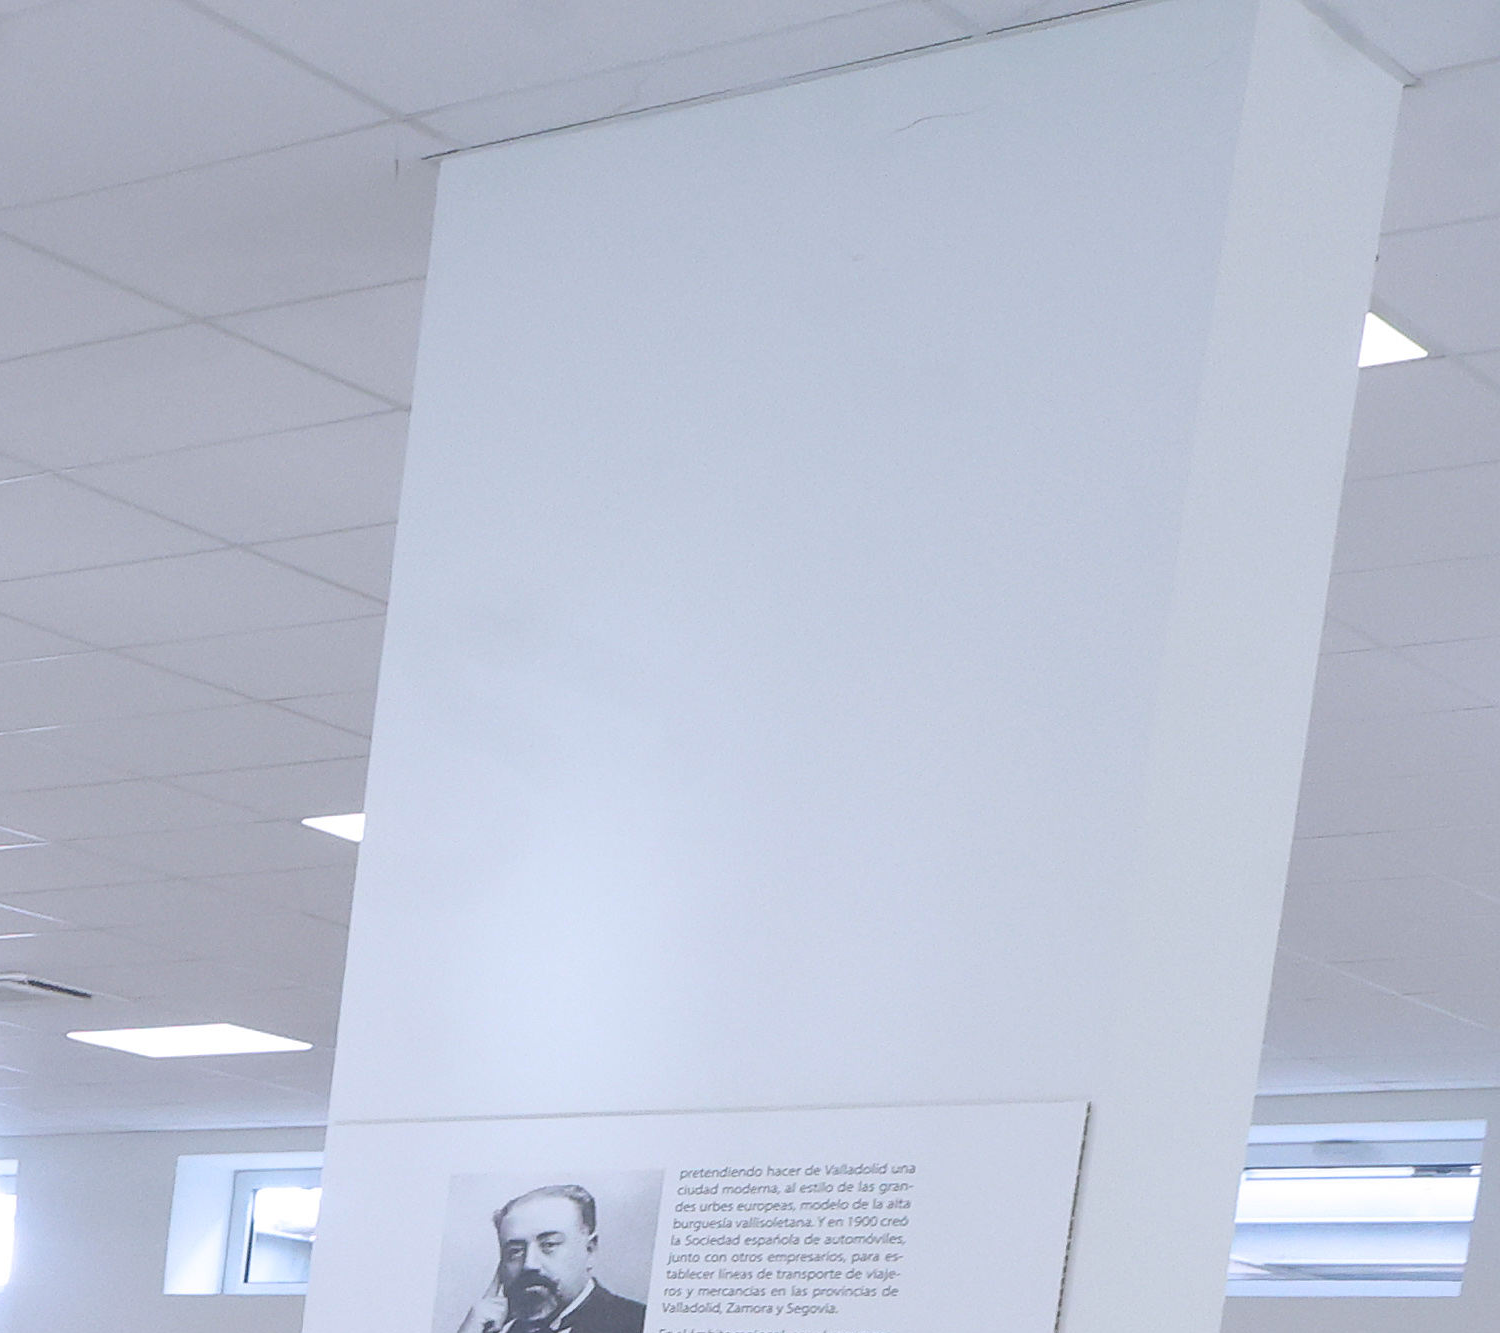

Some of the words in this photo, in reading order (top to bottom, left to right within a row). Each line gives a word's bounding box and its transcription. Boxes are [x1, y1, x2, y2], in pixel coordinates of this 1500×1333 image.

[679, 1165, 764, 1181] pretendiendo
[766, 1165, 803, 1177] hacer
[804, 1164, 822, 1176] de
[824, 1162, 889, 1176] Valladolid
[890, 1165, 917, 1174] una
[676, 1182, 720, 1196] ciudad
[721, 1182, 782, 1195] moderna,
[783, 1182, 797, 1194] al
[836, 1181, 855, 1193] de
[857, 1180, 876, 1192] las
[878, 1183, 915, 1195] gran-
[674, 1201, 697, 1212] des
[699, 1200, 735, 1212] urbes
[736, 1201, 797, 1213] europeas,
[800, 1198, 851, 1211] modelo
[851, 1197, 870, 1210] de
[872, 1198, 884, 1209] la
[672, 1217, 734, 1232] burguesía
[735, 1216, 815, 1229] vallisoletana.
[827, 1218, 845, 1227] en
[848, 1215, 879, 1227] 1900
[879, 1215, 910, 1227] creó
[670, 1234, 682, 1246] la
[684, 1233, 742, 1246] Sociedad
[743, 1233, 801, 1248] española
[803, 1233, 822, 1245] de
[823, 1232, 907, 1246] automóviles,
[666, 1252, 702, 1265] junto
[703, 1254, 728, 1263] con
[730, 1252, 764, 1263] otros
[766, 1250, 847, 1265] empresarios,
[850, 1252, 881, 1264] para
[884, 1252, 904, 1262] es-
[666, 1268, 716, 1280] tablecer
[718, 1268, 754, 1280] líneas
[756, 1267, 774, 1280] de
[776, 1269, 844, 1281] transporte
[844, 1267, 864, 1280] de
[866, 1268, 901, 1282] viaje-
[663, 1288, 683, 1297] ros
[685, 1288, 695, 1299] y
[697, 1285, 767, 1297] mercancías
[770, 1288, 787, 1296] en
[791, 1285, 809, 1297] las
[811, 1285, 878, 1299] provincias
[881, 1285, 900, 1297] de
[661, 1301, 724, 1315] Valladolid,
[725, 1301, 774, 1314] Zamora
[775, 1305, 785, 1316] y
[785, 1302, 839, 1317] Segovia.
